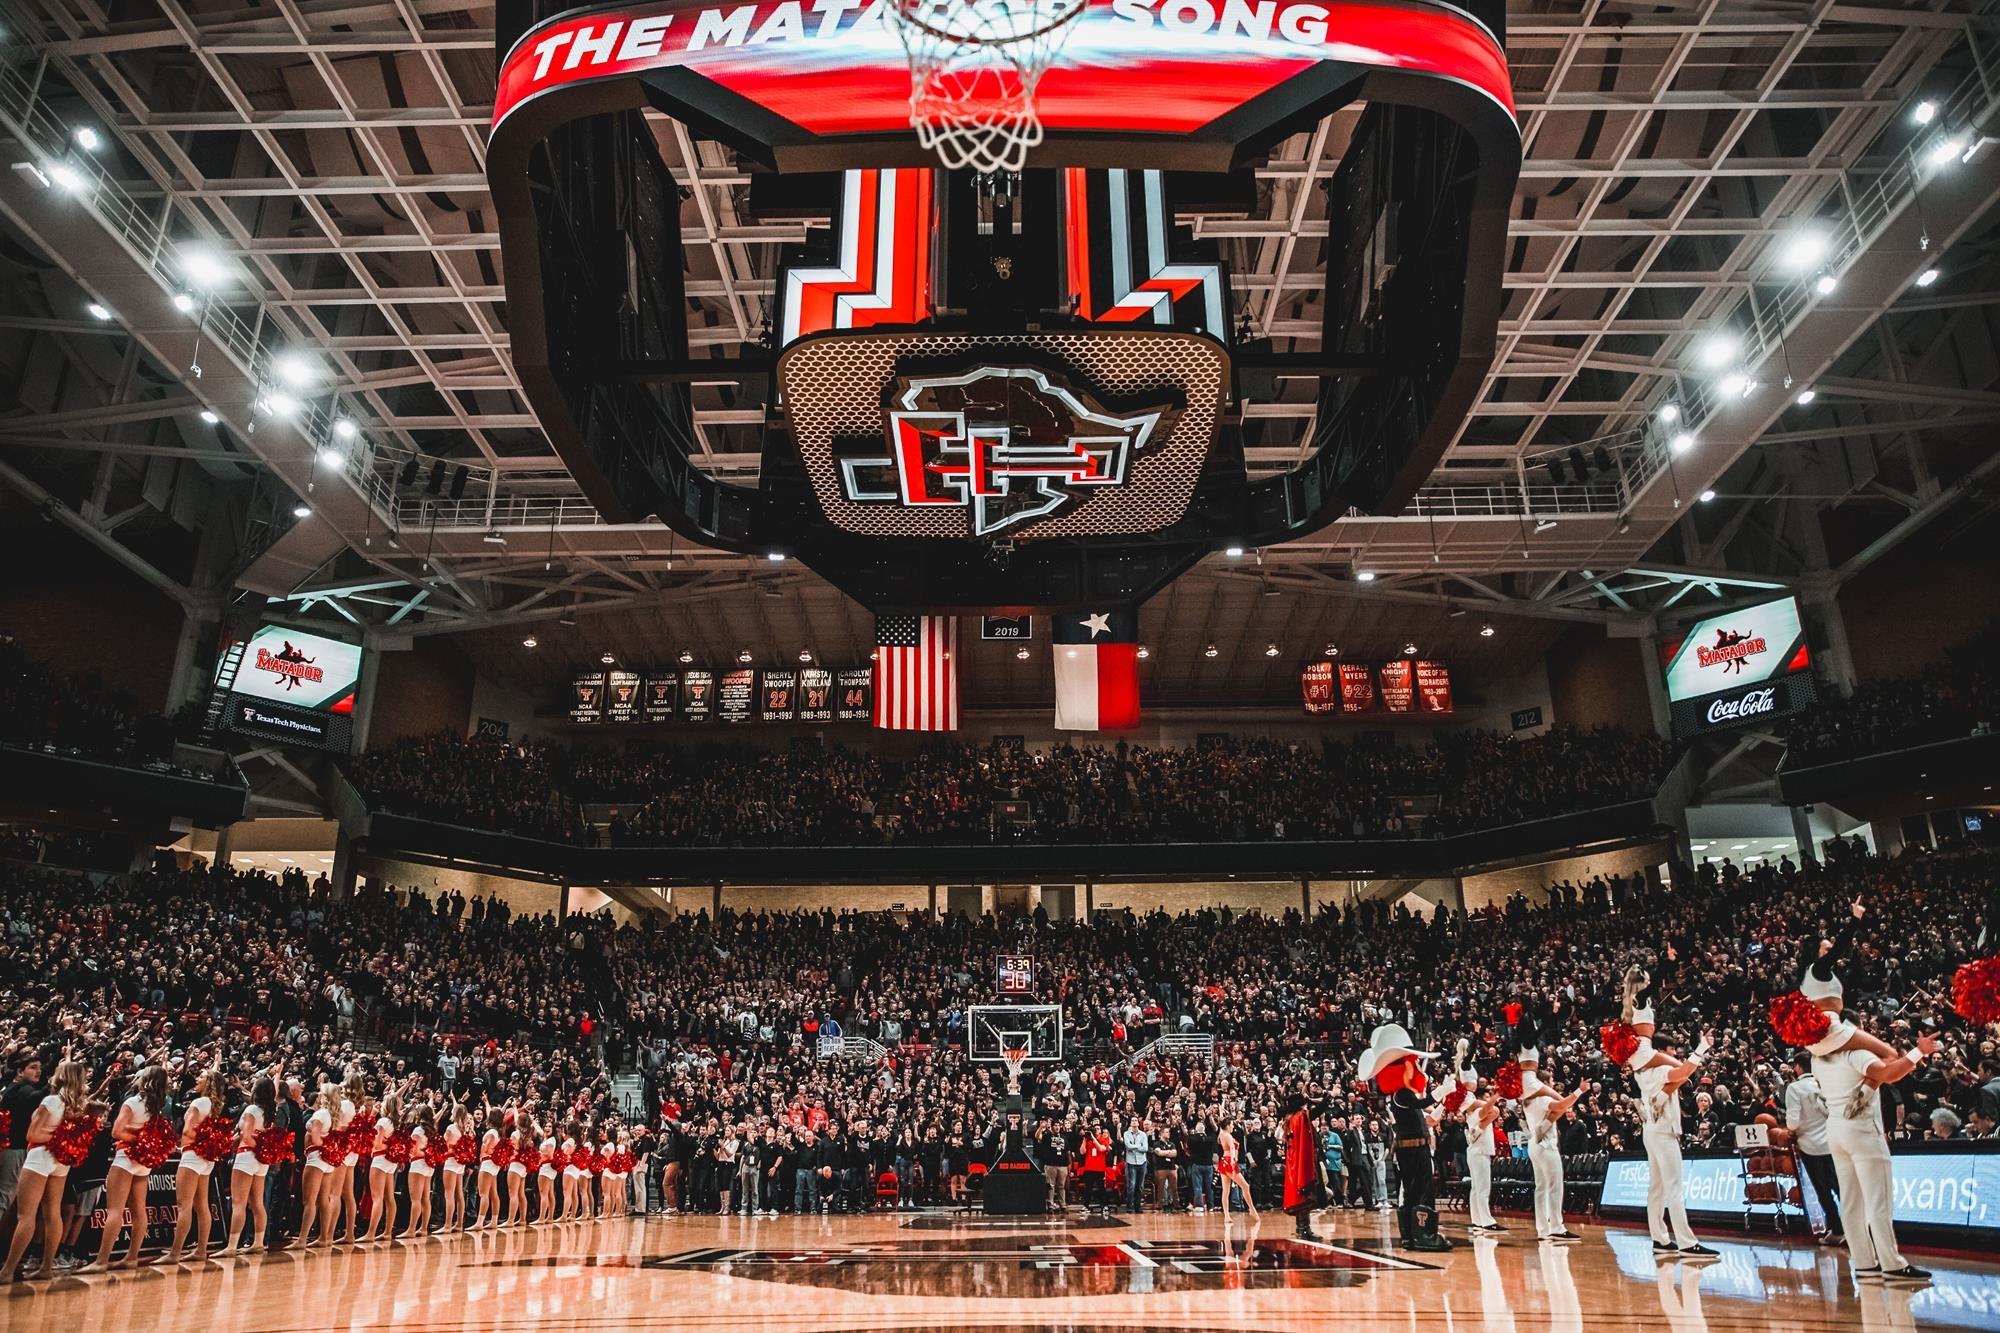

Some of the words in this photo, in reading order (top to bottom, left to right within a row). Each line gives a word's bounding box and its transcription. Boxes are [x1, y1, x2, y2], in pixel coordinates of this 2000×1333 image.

[533, 14, 673, 81] THE
[1110, 0, 1330, 45] SONG
[994, 627, 1018, 636] 2019
[1699, 637, 1767, 667] MATADOR
[256, 656, 323, 682] MATADOR
[803, 670, 828, 678] KRISTA
[1308, 664, 1324, 672] POLK
[1342, 664, 1368, 672] GERALD
[801, 679, 831, 687] KIRKLAND
[840, 678, 869, 686] THOMPSON
[808, 690, 824, 707] 21
[846, 689, 863, 706] 44
[1310, 684, 1328, 698] #1
[1344, 684, 1373, 698] #22
[770, 691, 787, 708] 22
[256, 714, 273, 724] Texas
[274, 717, 288, 726] Tech
[1518, 711, 1537, 726] 212
[480, 721, 504, 737] 206
[1006, 960, 1030, 970] 6:39
[1005, 971, 1026, 988] 30
[148, 1174, 176, 1190] HOUSE
[91, 1208, 132, 1229] RD
